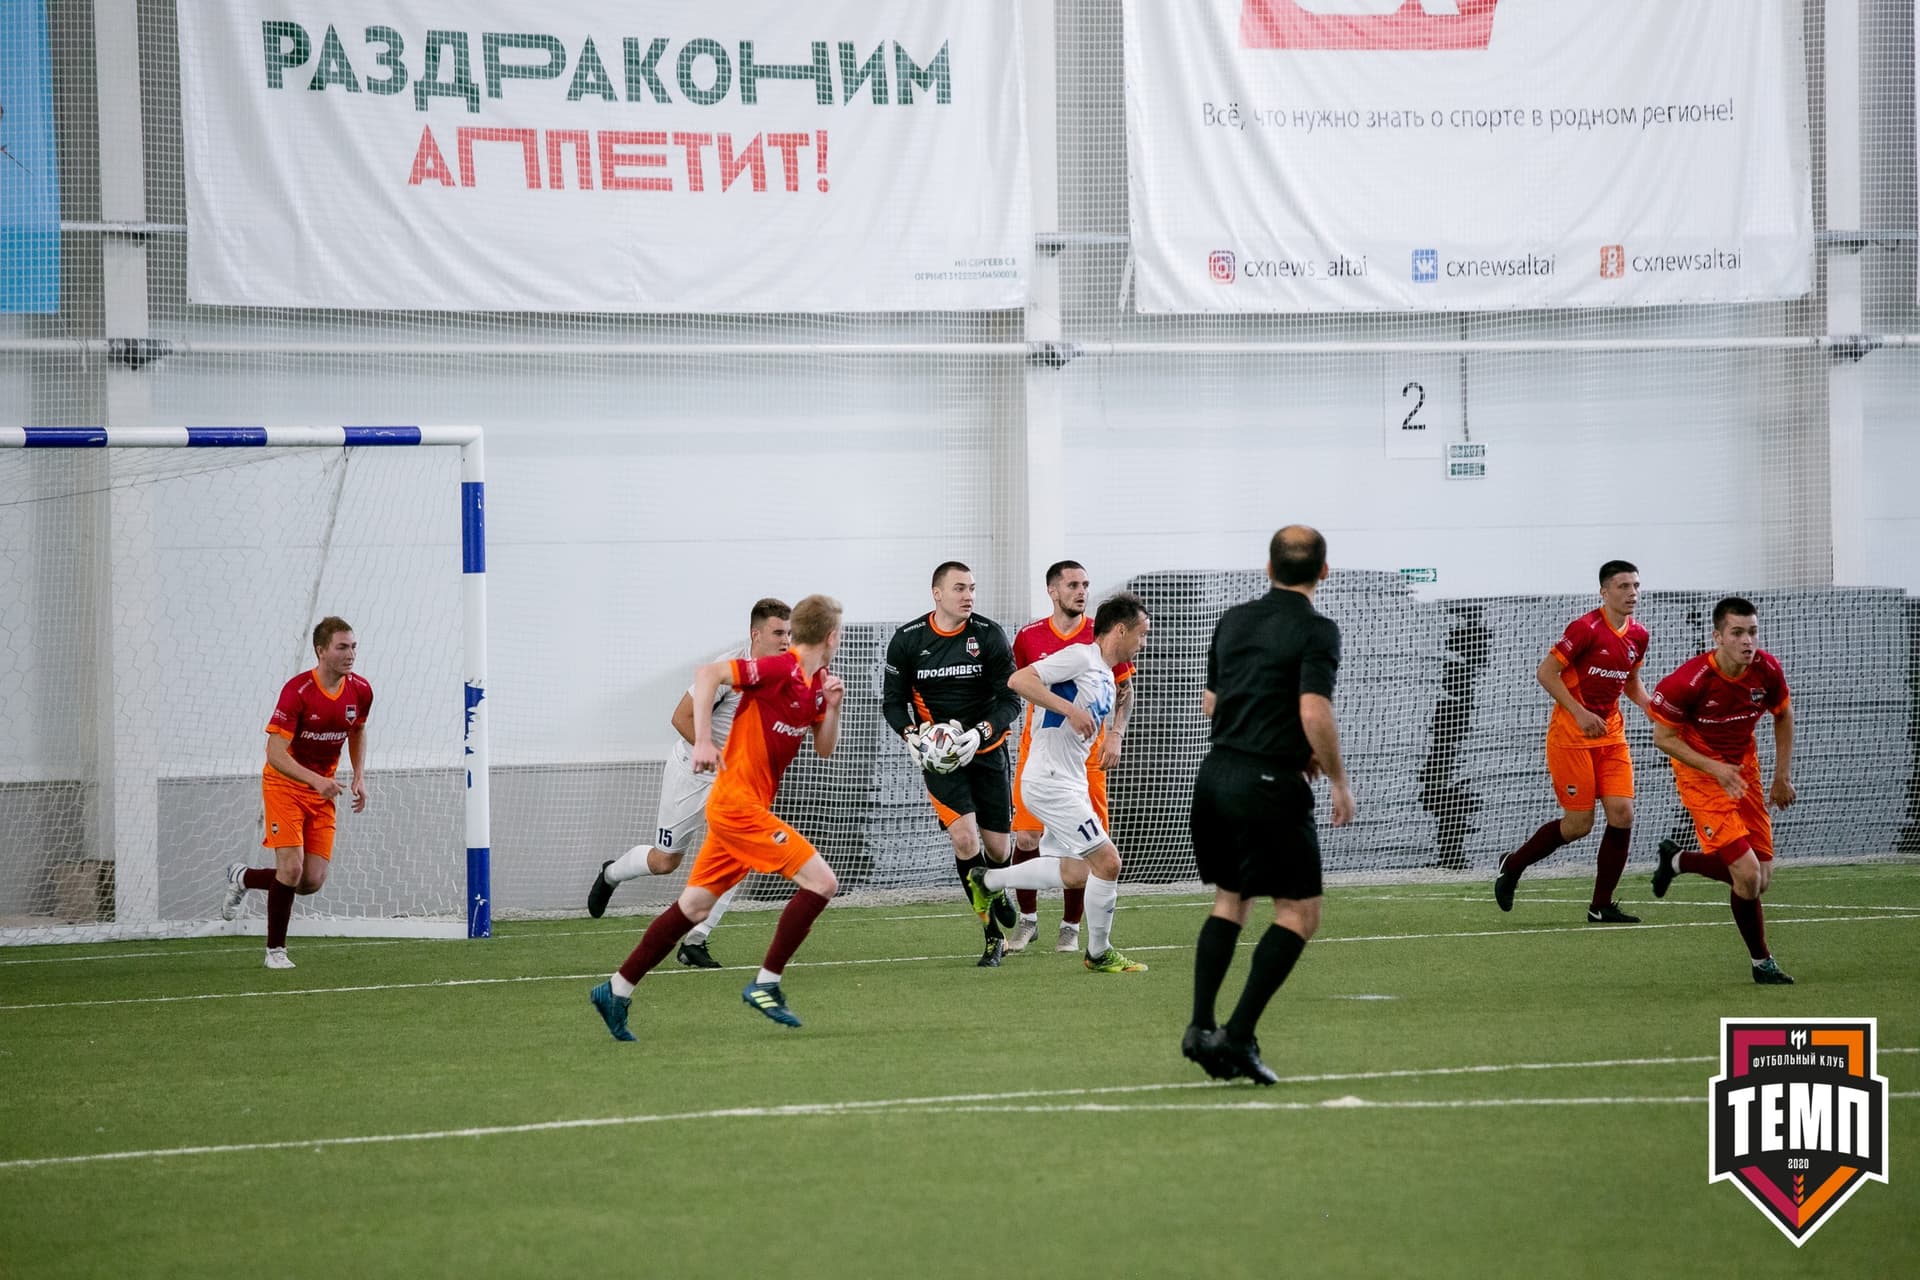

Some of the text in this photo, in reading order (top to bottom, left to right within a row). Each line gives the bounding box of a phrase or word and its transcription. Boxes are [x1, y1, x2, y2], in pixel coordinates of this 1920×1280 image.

[262, 20, 951, 113] РАЗДРАКОНИМ
[1202, 97, 1734, 134] Всё, что нужно знать о спорте в родном регионе!
[408, 123, 830, 193] АППЕТИТ!
[1446, 252, 1556, 277] cxnewsaltai
[1632, 247, 1742, 272] cxnewsaltai
[1402, 382, 1425, 430] 2
[917, 664, 983, 680] ПРОДИНВЕСТ
[658, 827, 672, 848] 15
[1077, 818, 1099, 842] 17
